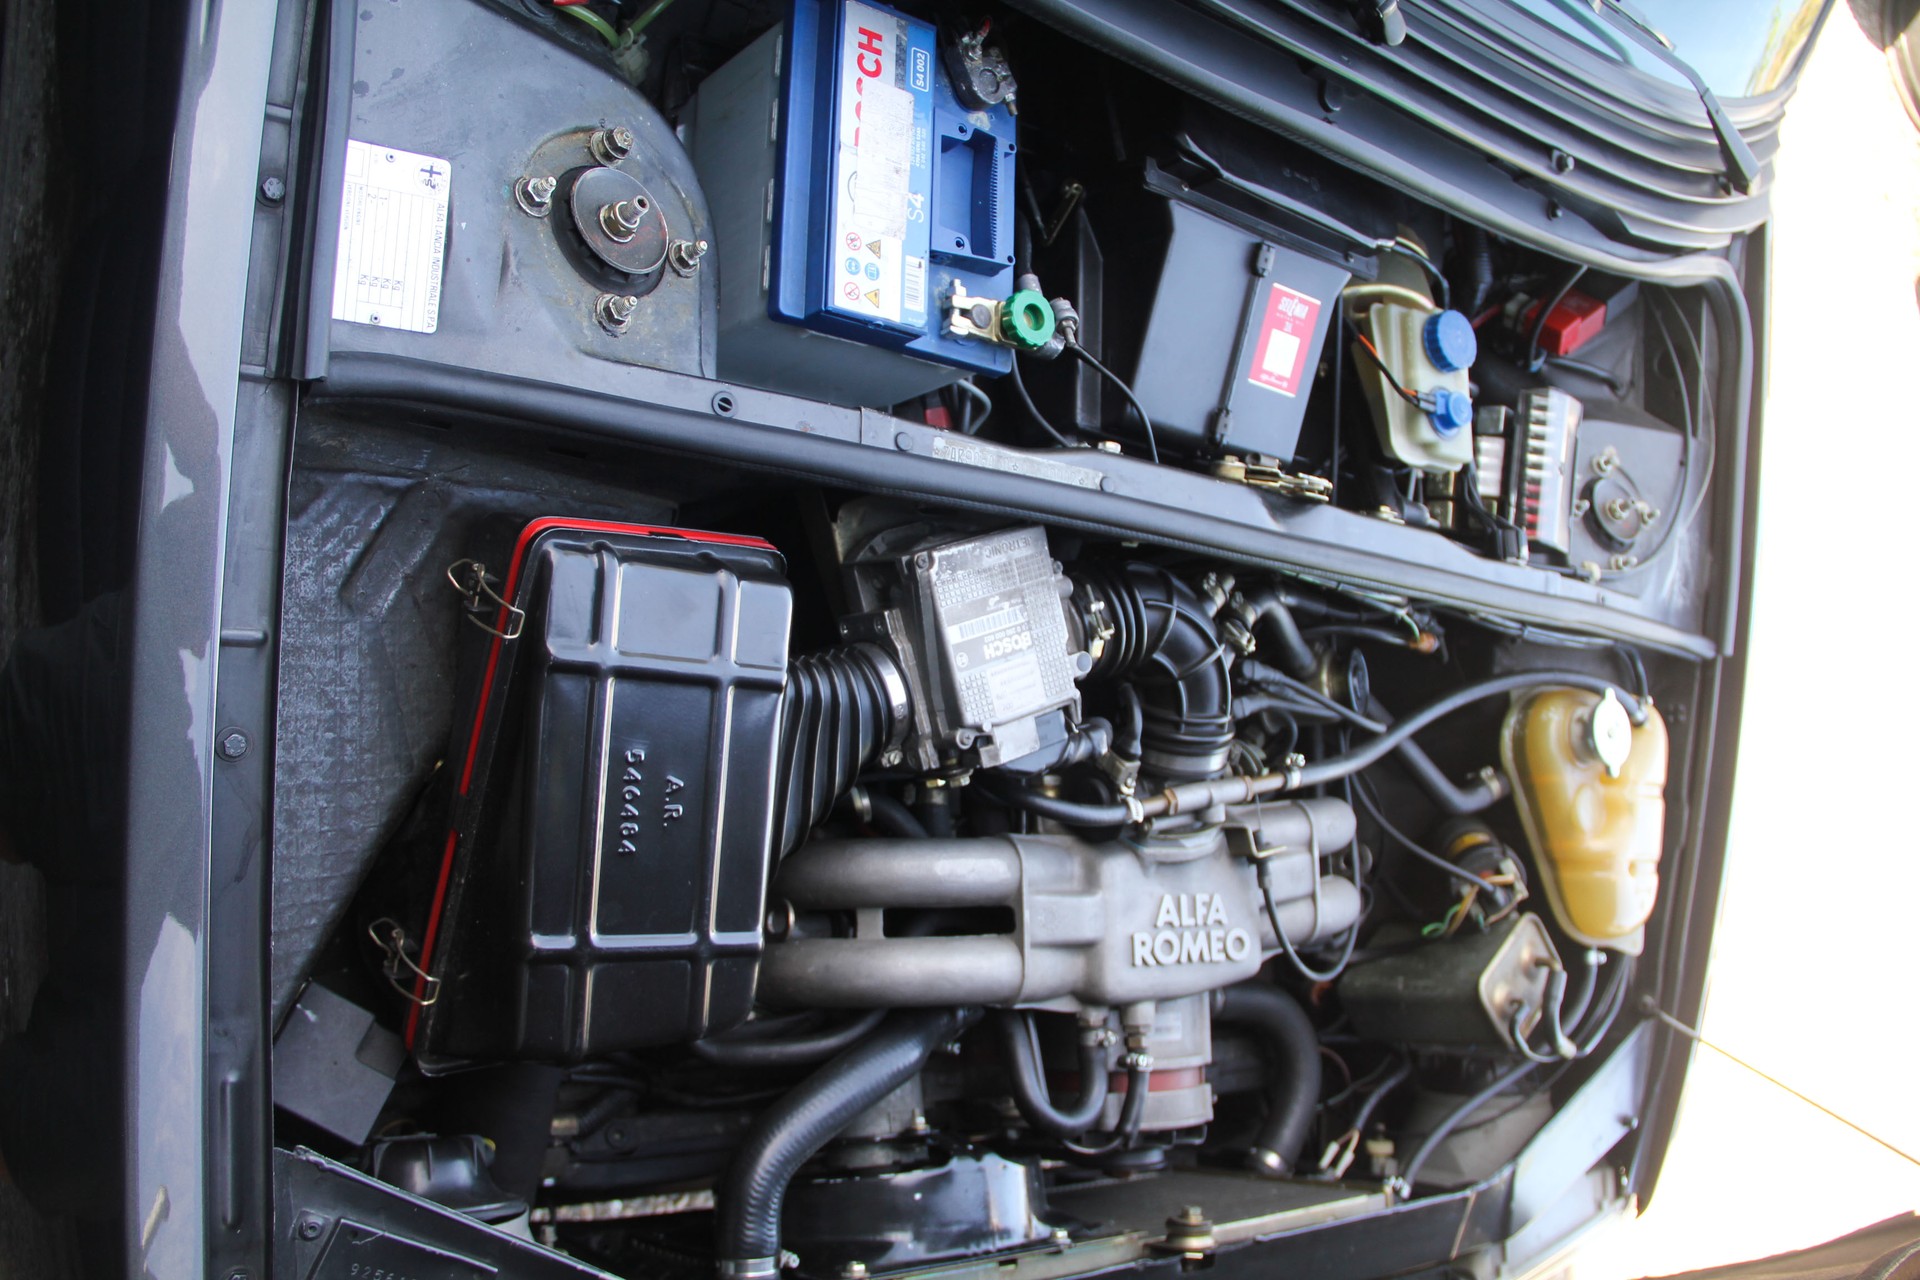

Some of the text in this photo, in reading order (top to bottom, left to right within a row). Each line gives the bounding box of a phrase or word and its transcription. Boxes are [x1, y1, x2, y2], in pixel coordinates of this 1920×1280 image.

[915, 52, 925, 87] S4 002
[436, 203, 445, 222] ALFA
[908, 193, 925, 224] S4
[433, 225, 443, 254] LANCIA
[358, 274, 369, 285] Kg
[369, 276, 380, 287] Kg
[380, 278, 391, 289] Kg
[392, 280, 403, 291] Kg
[428, 257, 440, 307] INDUSTRIALE
[984, 536, 1031, 558] JETRONIC
[983, 631, 1032, 660] BOSCH
[618, 749, 645, 852] 546484
[663, 775, 684, 827] A.R.
[1154, 893, 1228, 928] ALFA
[1131, 928, 1251, 967] ROMEO
